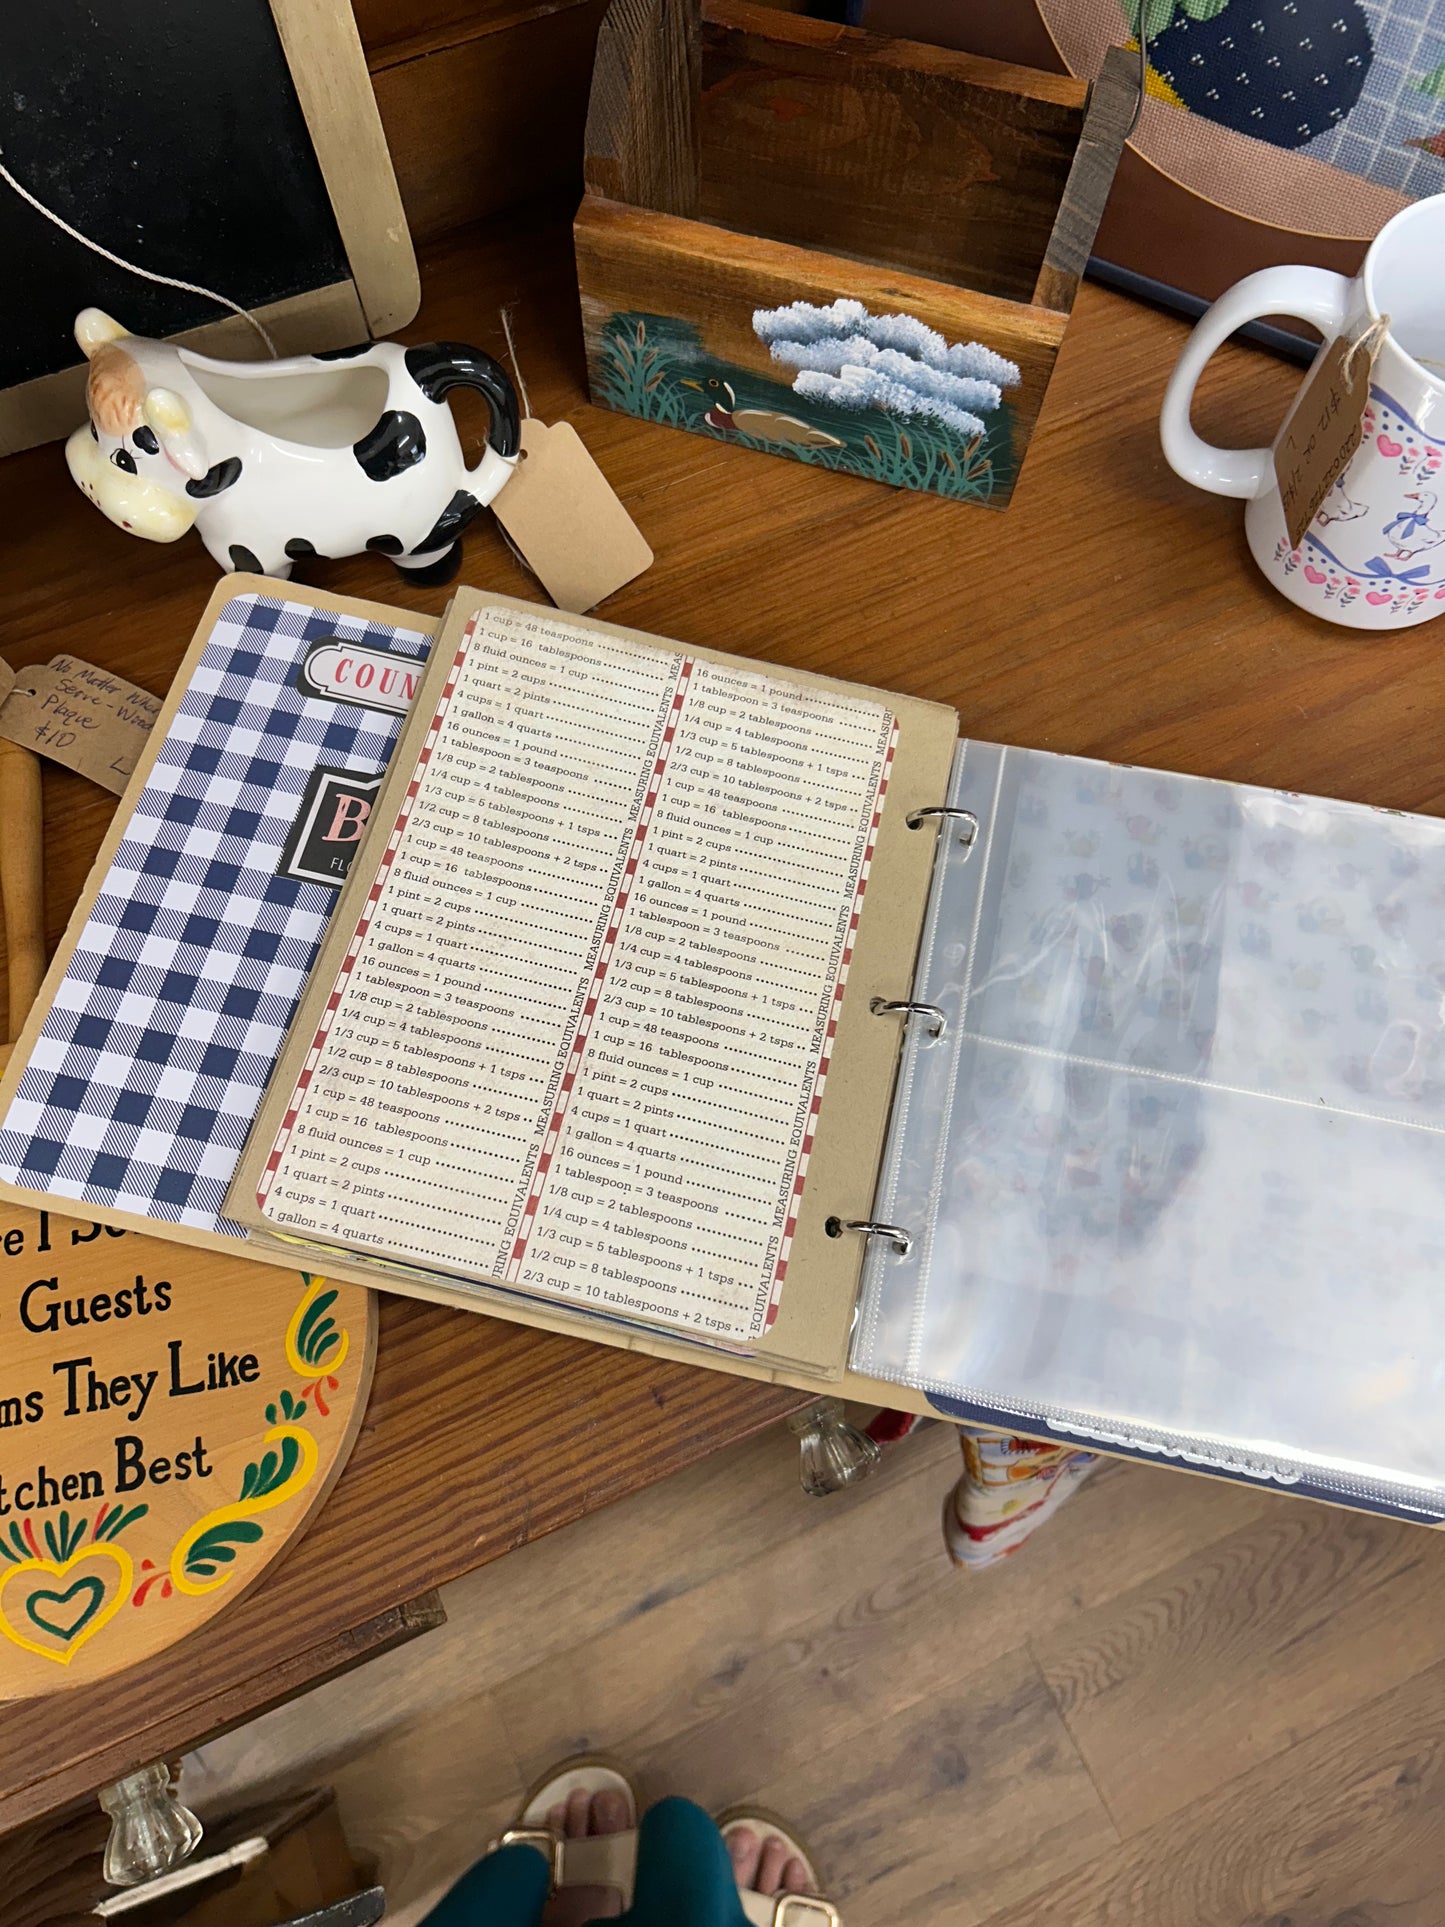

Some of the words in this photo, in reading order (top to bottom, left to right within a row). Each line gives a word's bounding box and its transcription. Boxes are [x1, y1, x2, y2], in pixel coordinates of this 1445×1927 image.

[51, 659, 73, 674] No
[75, 669, 122, 694] Matter
[334, 657, 421, 701] COUN
[473, 642, 481, 651] 8
[482, 645, 507, 658] fluid
[509, 654, 547, 669] ounces
[560, 665, 565, 674] 1
[568, 669, 588, 681] cup
[55, 679, 103, 705] Serve
[696, 668, 709, 678] 16
[710, 674, 748, 688] ounces
[760, 684, 766, 693] 1
[768, 688, 805, 702] pound
[41, 694, 100, 729] Plaque
[452, 705, 458, 714] 1
[460, 709, 495, 724] gallon
[506, 720, 514, 729] 4
[516, 724, 552, 739] quarts
[684, 713, 700, 725] 1/4
[702, 720, 723, 731] cup
[734, 726, 742, 735] 4
[744, 729, 808, 751] tablespoons
[35, 720, 76, 748] $10
[436, 751, 454, 763] 1/8
[455, 758, 477, 770] cup
[488, 765, 497, 775] 2
[498, 769, 565, 792] tablespoons
[442, 735, 447, 744] 1
[451, 738, 511, 761] tablespoon
[523, 757, 531, 766] 3
[533, 760, 589, 781] teaspoons
[667, 777, 672, 786] 1
[674, 781, 695, 793] cup
[707, 788, 721, 798] 48
[723, 792, 778, 812] teaspoons
[321, 793, 371, 842] B
[411, 817, 431, 829] 2/3
[432, 824, 454, 836] cup
[468, 831, 481, 842] 10
[483, 836, 551, 860] tablespoons
[563, 856, 571, 865] 2
[573, 859, 597, 871] tsps
[653, 825, 658, 834] 1
[660, 829, 684, 841] pint
[695, 836, 703, 845] 2
[705, 840, 732, 852] cups
[642, 859, 650, 868] 4
[651, 863, 679, 875] cups
[692, 870, 697, 879] 1
[700, 874, 731, 888] quart
[388, 885, 394, 894] 1
[396, 889, 421, 901] pint
[433, 896, 442, 906] 2
[443, 901, 472, 913] cups
[629, 907, 635, 916] 1
[638, 910, 700, 932] tablespoon
[713, 927, 721, 936] 3
[723, 930, 780, 951] teaspoons
[368, 937, 375, 947] 1
[376, 942, 414, 956] gallon
[427, 952, 435, 961] 4
[437, 956, 476, 971] quarts
[503, 1143, 540, 1237] EQUIVALENTS
[533, 1060, 565, 1137] MEASURING
[556, 976, 590, 1060] EQUIVALENTS
[583, 904, 612, 972] MEASURING
[603, 827, 634, 903] EQUIVALENTS
[627, 759, 653, 823] MEASURING
[645, 686, 674, 758] EQUIVALENTS
[356, 971, 362, 980] 1
[365, 974, 430, 997] tablespoon
[444, 992, 452, 1002] 3
[455, 996, 515, 1017] teaspoons
[614, 958, 633, 971] 1/3
[634, 965, 656, 978] cup
[669, 971, 677, 981] 5
[679, 975, 748, 998] tablespoons
[762, 994, 767, 1004] 1
[771, 998, 796, 1011] tsps
[749, 1235, 779, 1333] EQUIVALENTS
[771, 1149, 798, 1229] MEASURING
[789, 1060, 817, 1147] EQUIVALENTS
[809, 984, 833, 1055] MEASURING
[824, 904, 850, 982] EQUIVALENTS
[843, 835, 866, 900] MEASURING
[857, 760, 882, 833] EQUIVALENTS
[587, 1048, 596, 1058] 8
[597, 1050, 625, 1066] fluid
[626, 1060, 669, 1076] ounces
[683, 1072, 689, 1082] 1
[692, 1076, 714, 1089] cup
[318, 1064, 340, 1077] 2/3
[341, 1072, 365, 1085] cup
[379, 1079, 394, 1090] 10
[396, 1083, 470, 1109] tablespoons
[483, 1104, 492, 1115] 2
[494, 1108, 521, 1121] tsps
[560, 1144, 574, 1157] 16
[576, 1152, 620, 1169] ounces
[635, 1163, 641, 1174] 1
[643, 1168, 683, 1185] pound
[0, 1229, 24, 1256] e
[267, 1206, 274, 1218] 1
[276, 1212, 317, 1228] gallon
[331, 1223, 340, 1234] 4
[342, 1228, 384, 1245] quarts
[20, 1275, 172, 1333] Guests
[522, 1269, 544, 1283] 2/3
[546, 1277, 570, 1291] cup
[586, 1284, 601, 1297] 10
[603, 1290, 679, 1318] tablespoons
[693, 1312, 702, 1324] 2
[705, 1316, 732, 1331] tsps
[53, 1356, 159, 1422] They
[168, 1340, 260, 1397] Like
[115, 1435, 213, 1494] Best
